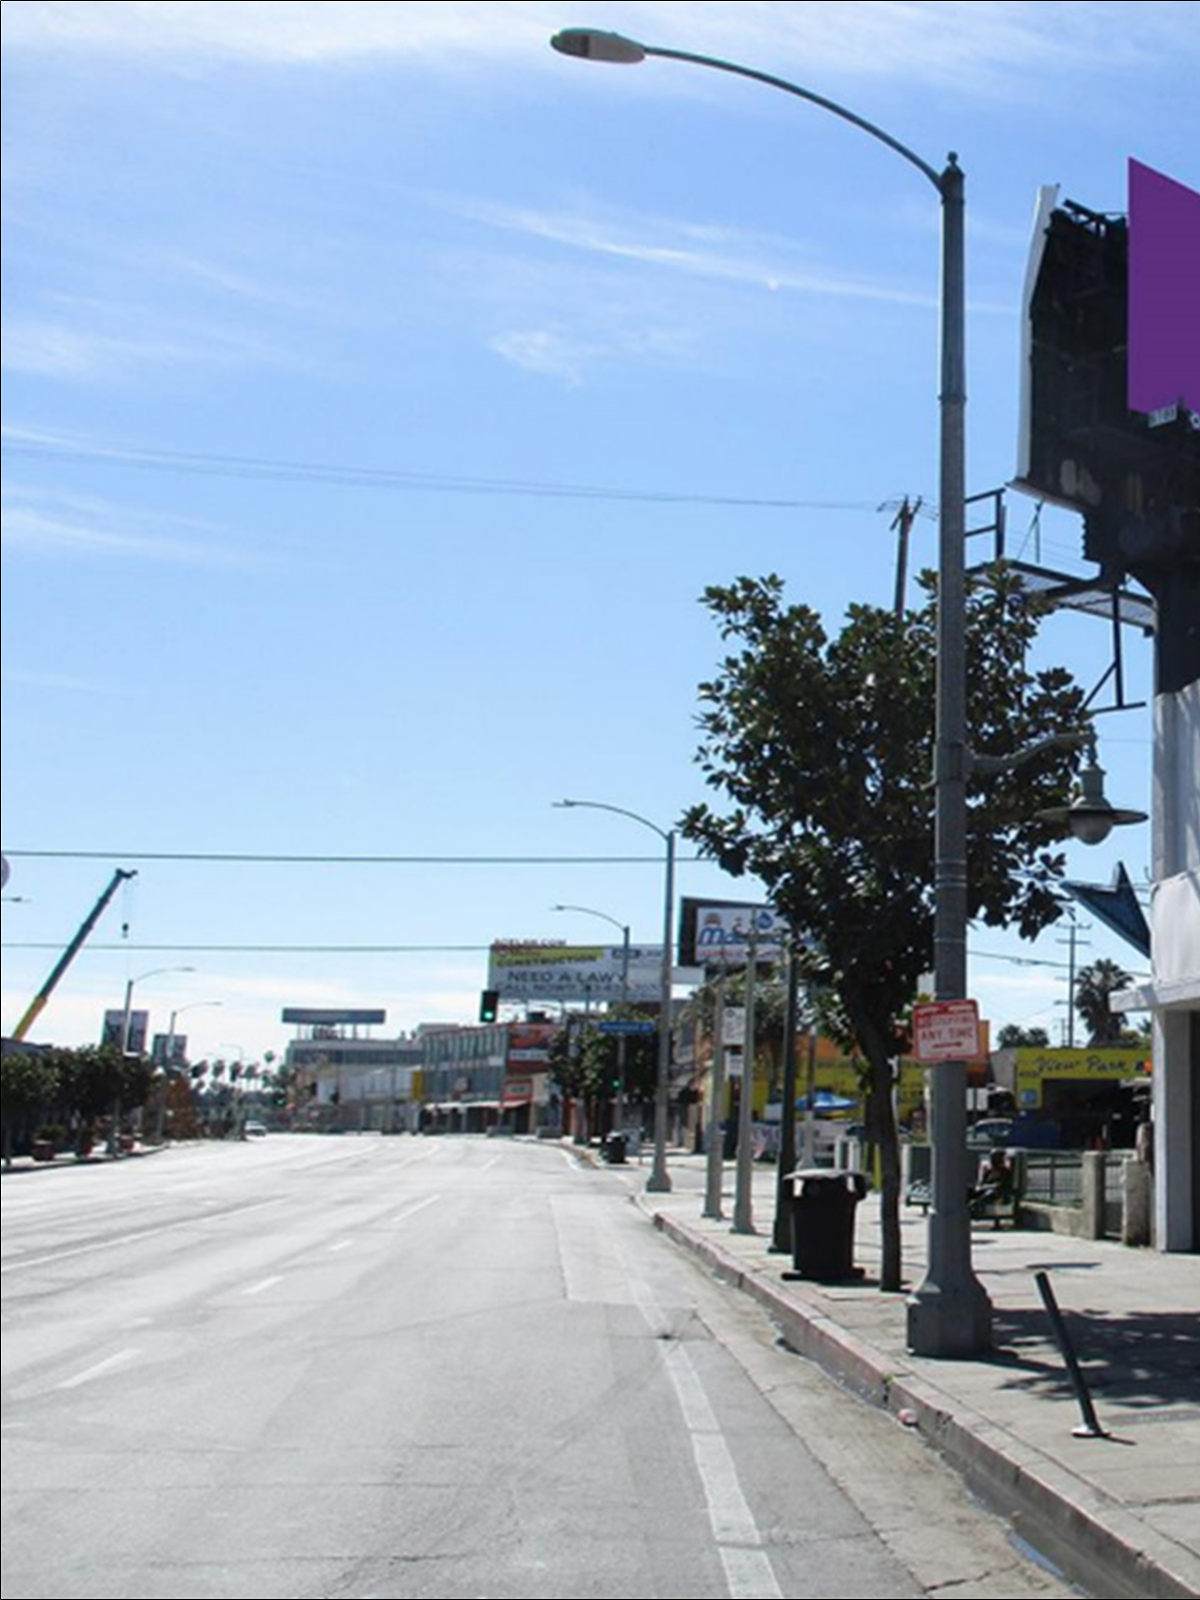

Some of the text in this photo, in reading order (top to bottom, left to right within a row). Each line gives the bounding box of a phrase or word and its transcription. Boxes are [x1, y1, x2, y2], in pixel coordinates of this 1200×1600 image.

[508, 971, 553, 982] NEED
[560, 971, 571, 982] A
[921, 1030, 943, 1040] ANY
